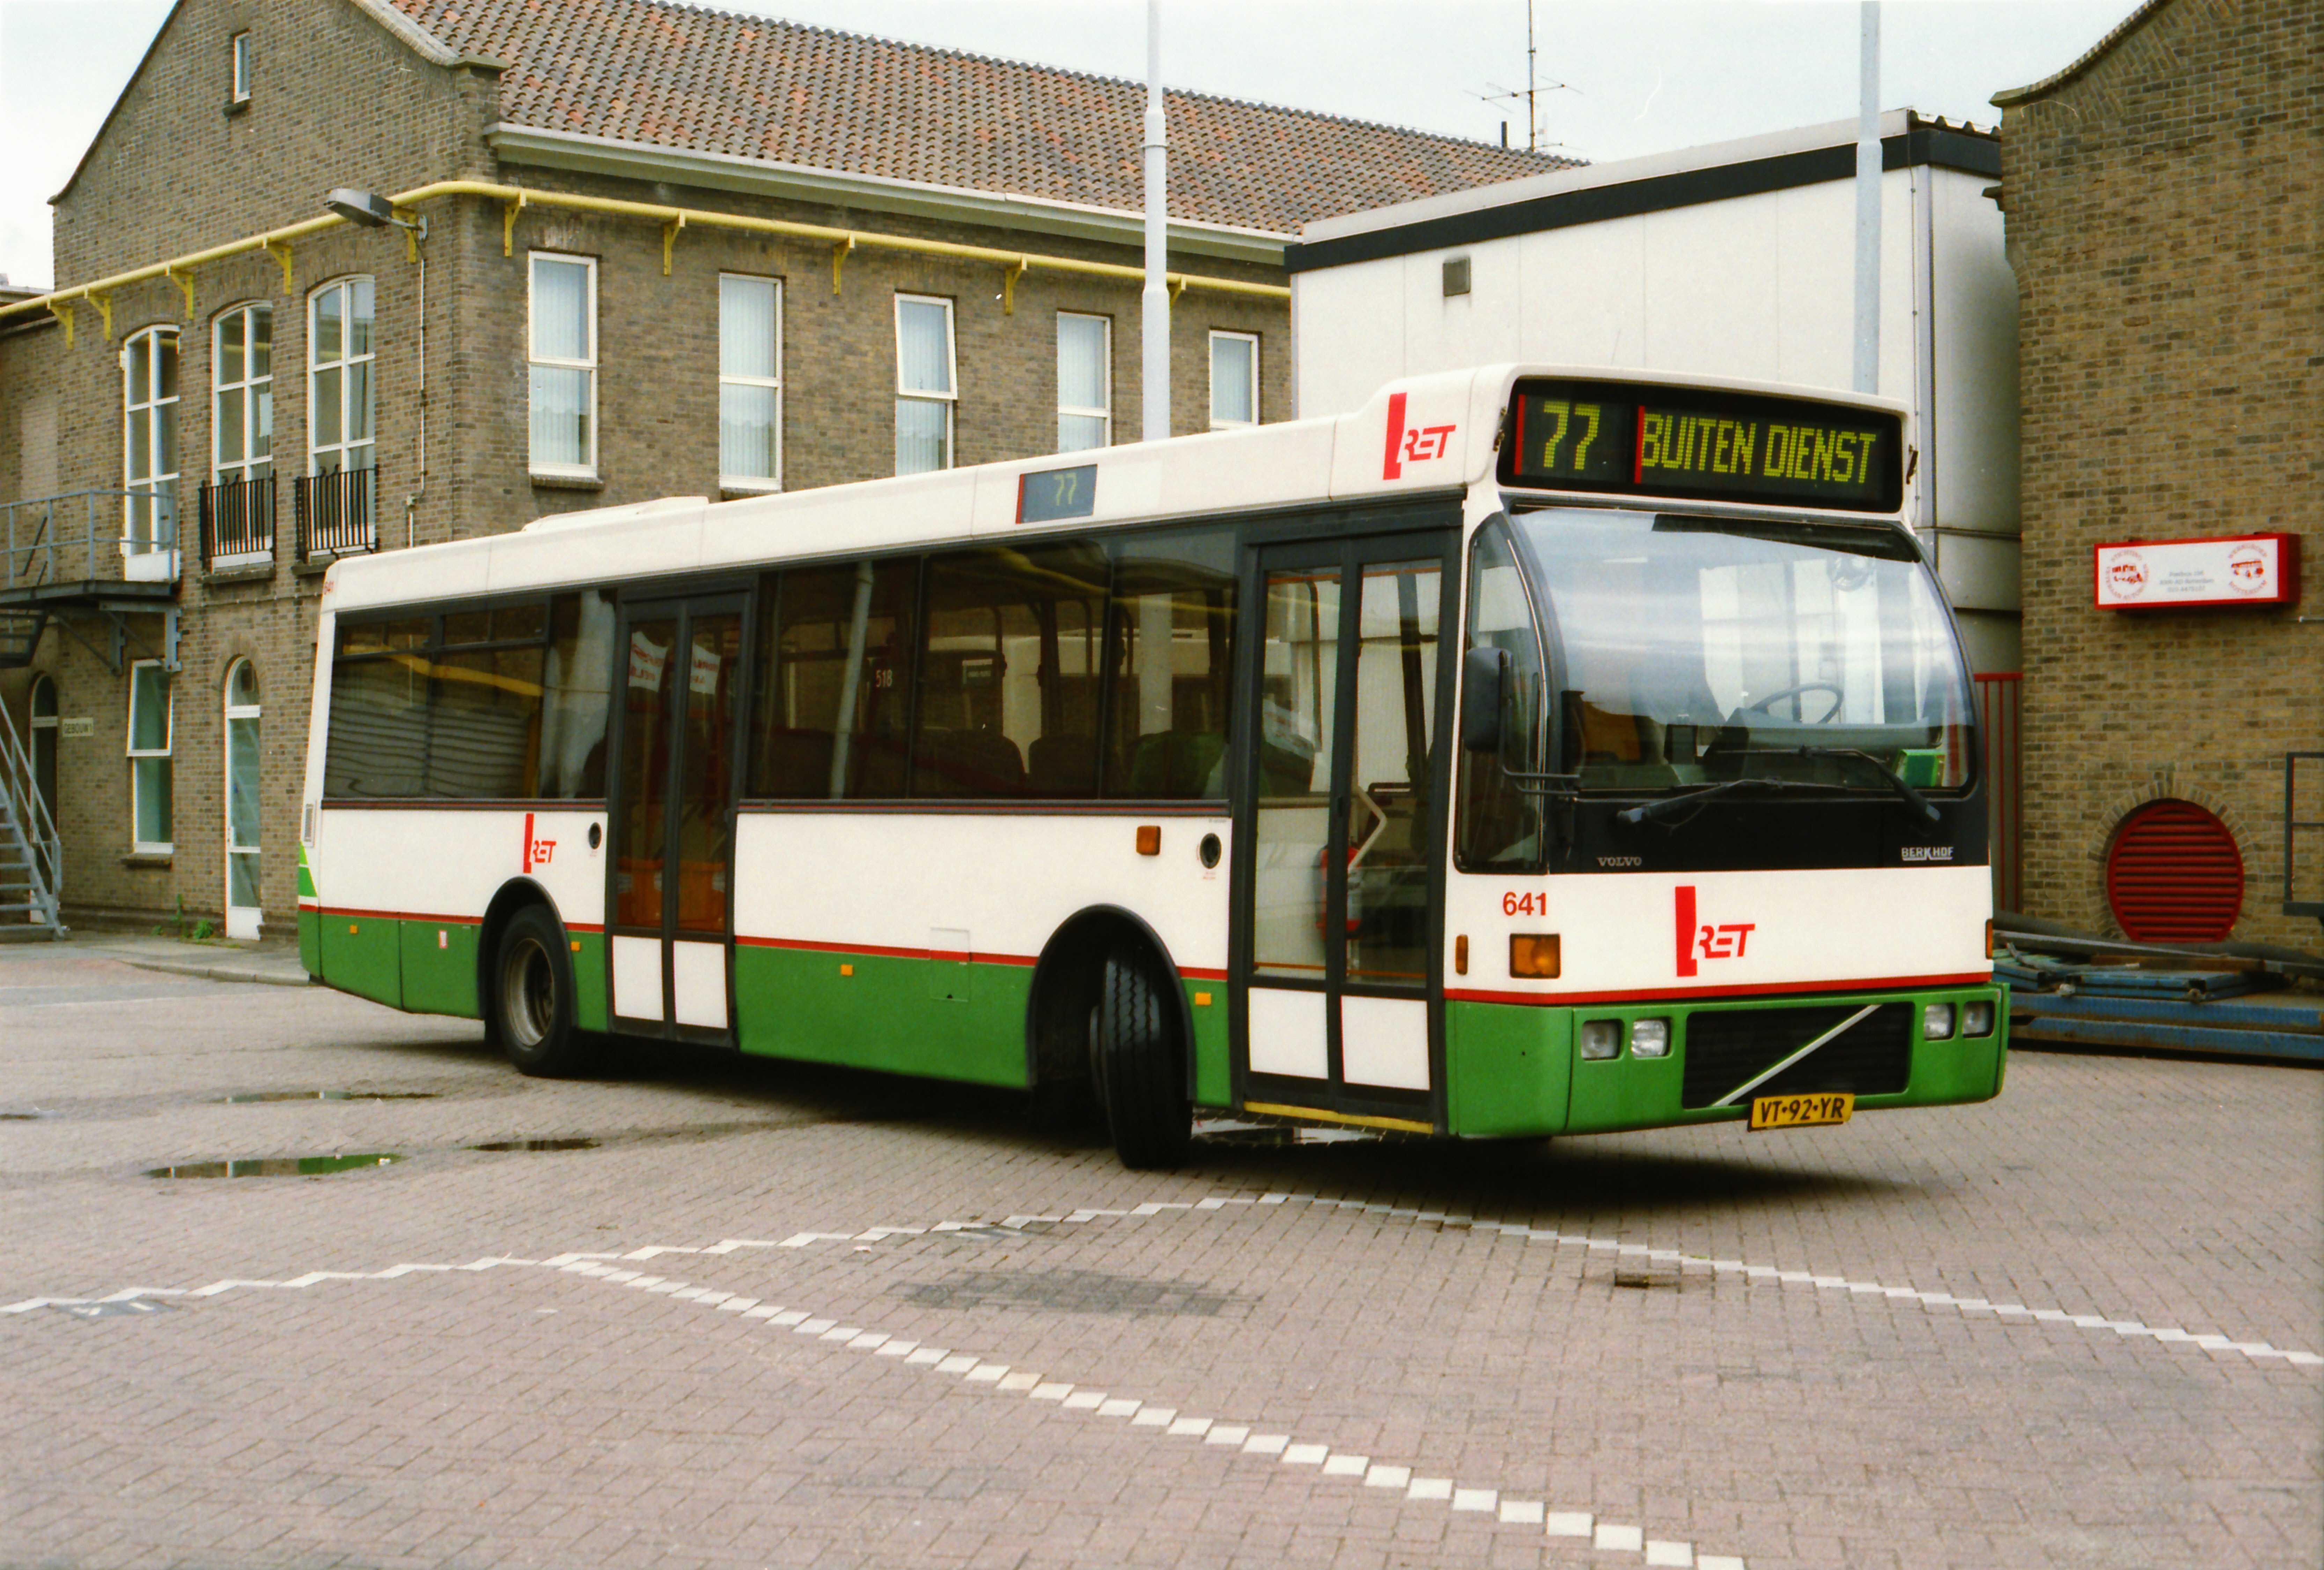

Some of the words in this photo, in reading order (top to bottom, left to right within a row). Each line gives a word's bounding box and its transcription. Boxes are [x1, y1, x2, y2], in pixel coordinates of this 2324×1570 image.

[1402, 425, 1456, 461] RET
[1544, 401, 1601, 470] 77
[1642, 413, 1756, 475] BUITEN
[1764, 424, 1876, 484] DIENST
[1053, 472, 1077, 507] 77
[532, 840, 557, 863] RET
[1597, 856, 1642, 867] VOLVO
[1901, 846, 1954, 860] BERKHOF
[1502, 892, 1547, 917] 641
[1698, 923, 1755, 959] RET
